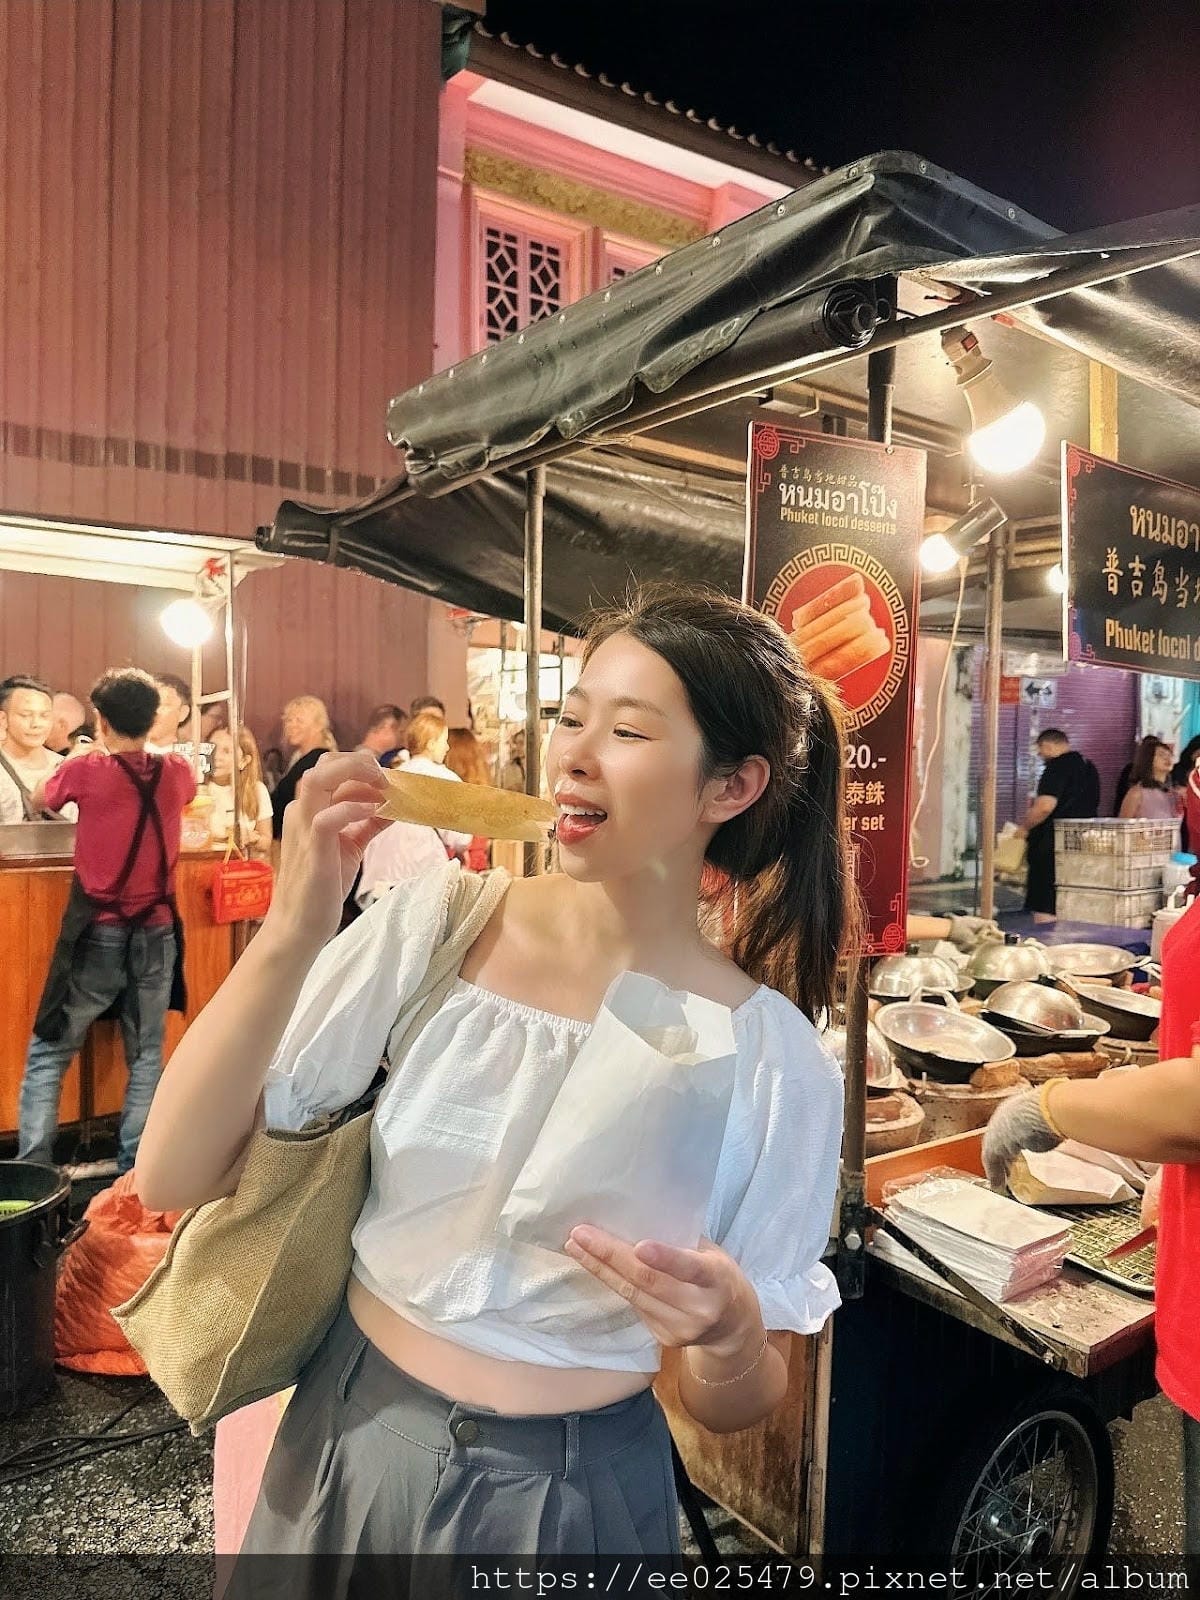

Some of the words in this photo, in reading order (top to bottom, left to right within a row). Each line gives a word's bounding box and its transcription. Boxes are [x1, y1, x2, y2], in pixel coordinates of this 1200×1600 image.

[779, 481, 898, 520] หนมอาโป๊ง
[780, 506, 819, 525] Phuket
[851, 516, 897, 535] desserts
[1105, 618, 1155, 655] Phuket
[1158, 628, 1191, 660] local
[843, 816, 858, 831] er
[861, 814, 885, 831] set
